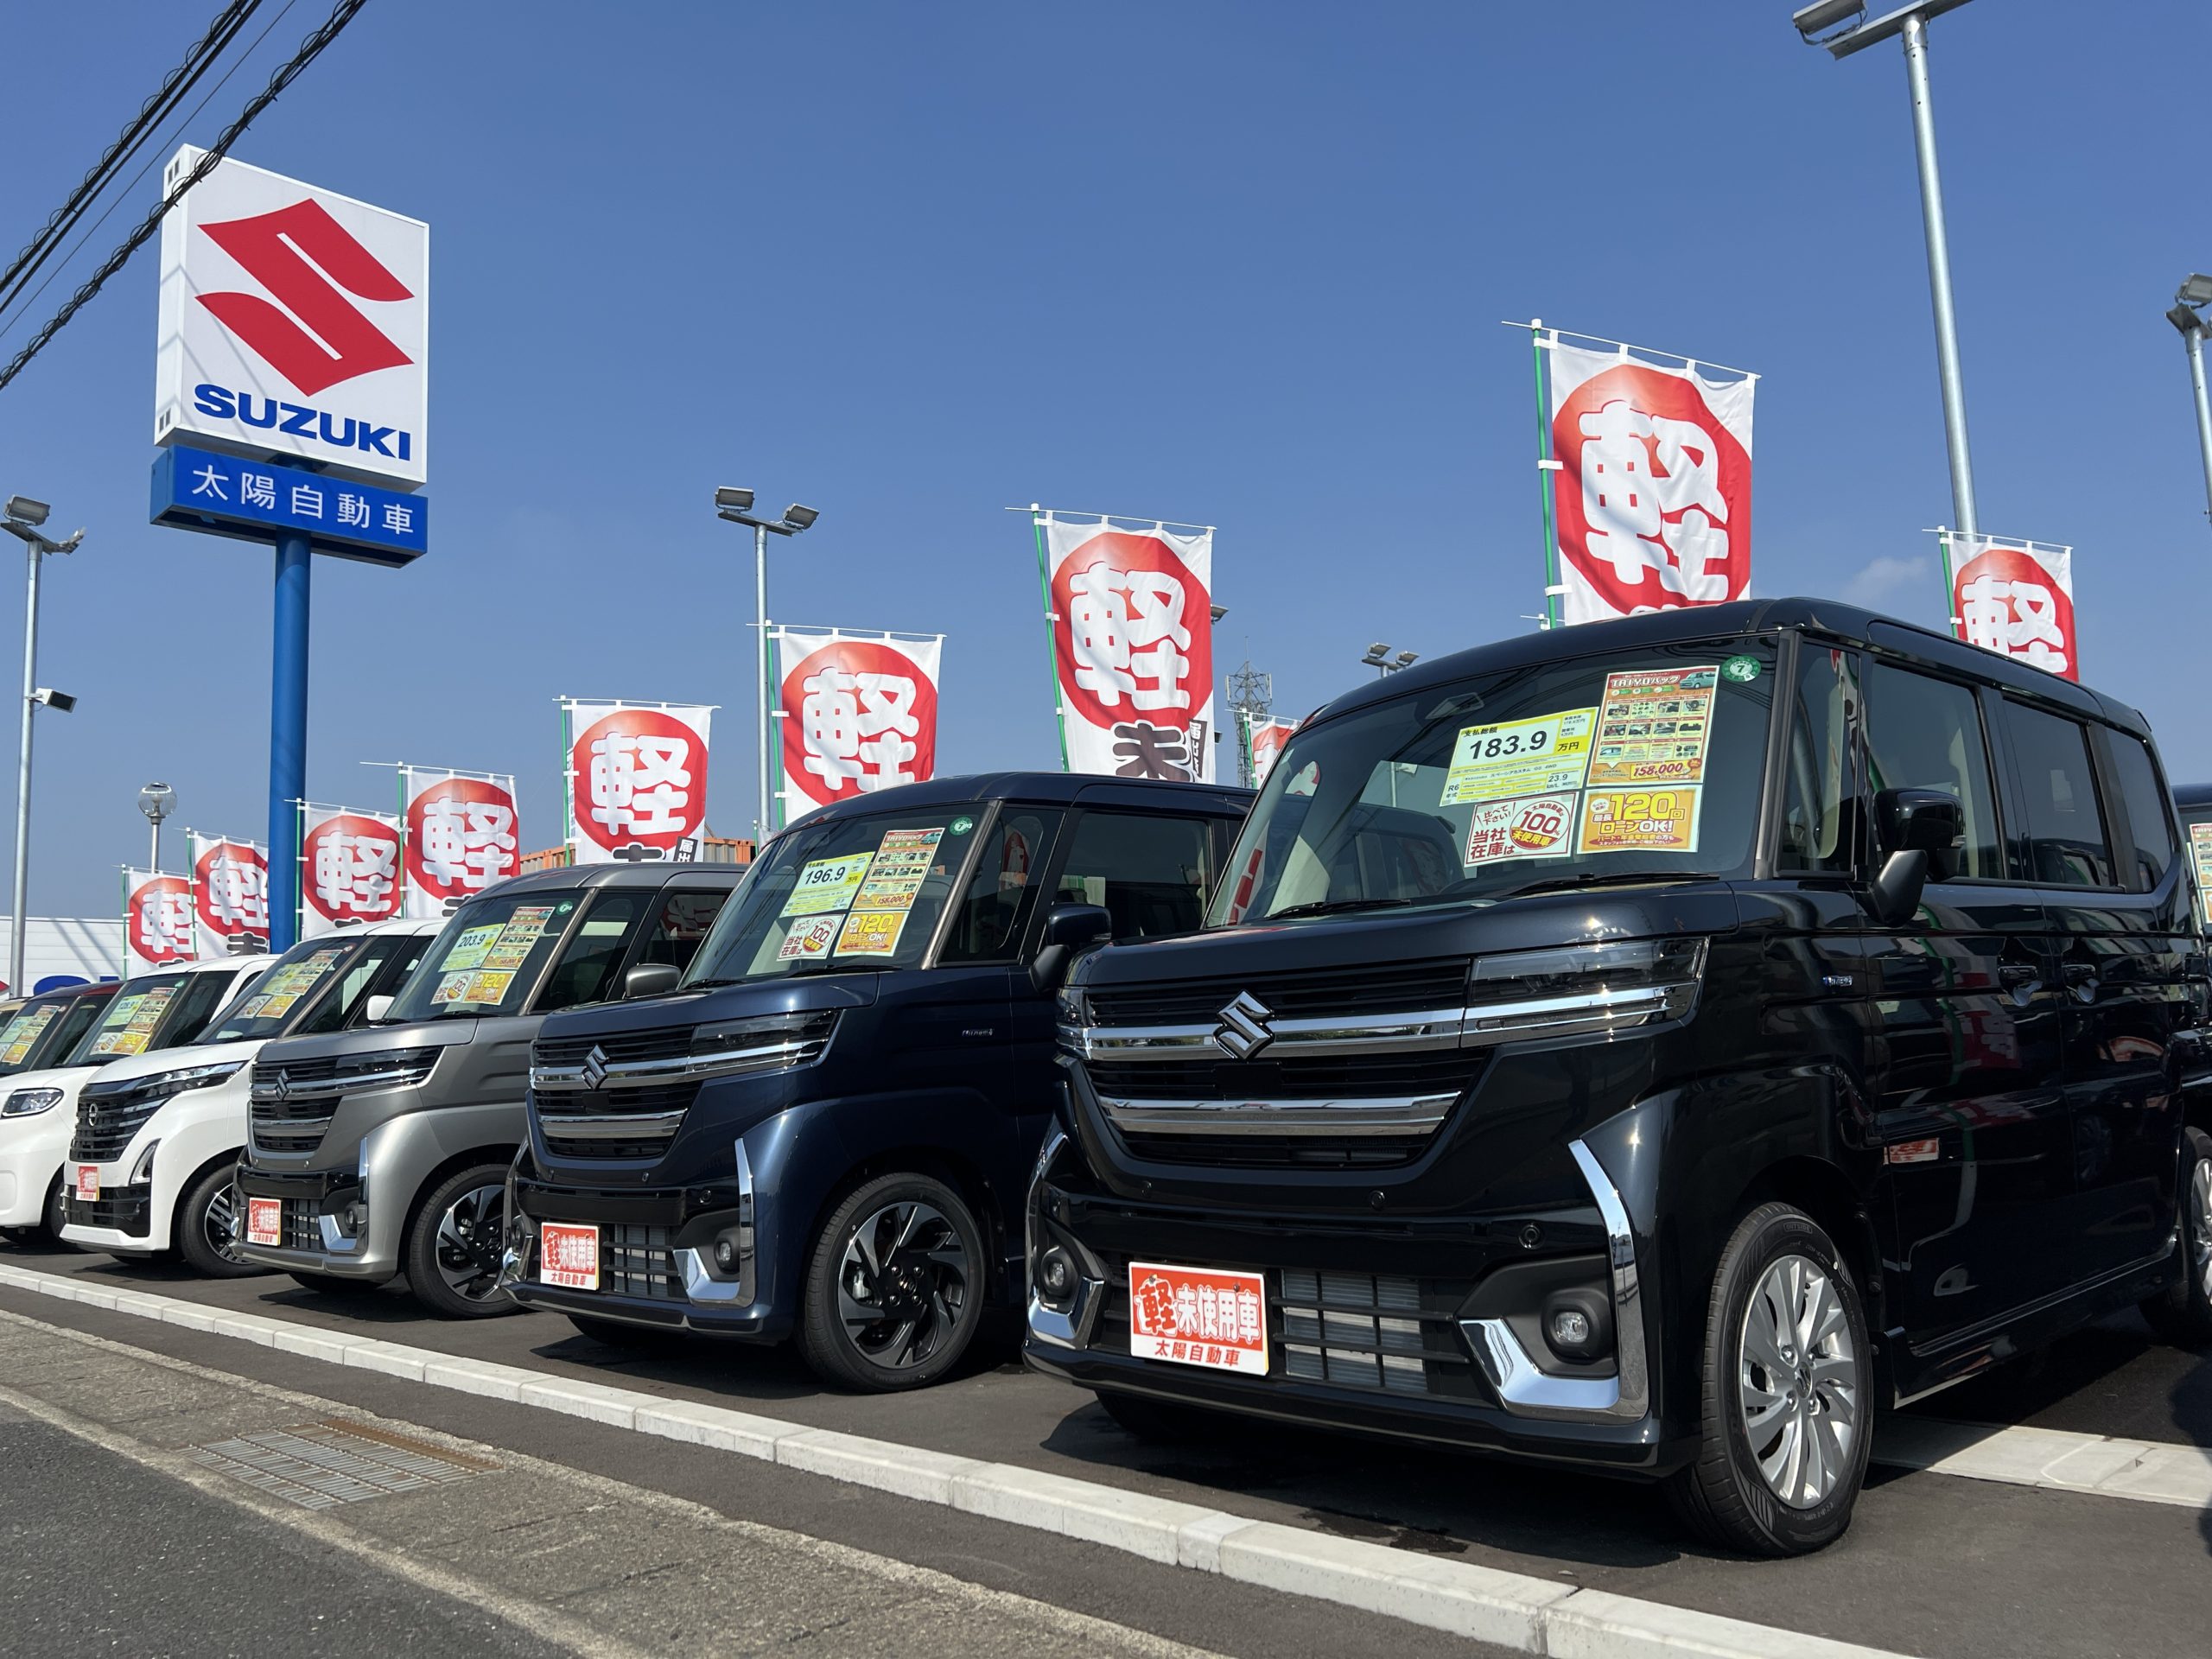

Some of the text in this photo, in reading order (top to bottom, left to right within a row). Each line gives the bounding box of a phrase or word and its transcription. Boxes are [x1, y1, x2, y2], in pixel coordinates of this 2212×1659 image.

[194, 384, 410, 461] SUZUKI
[192, 464, 414, 535] 太陽自動車
[1579, 400, 1729, 601] 軽
[1069, 562, 1192, 710] 軽
[1961, 575, 2069, 674] 軽
[1737, 664, 1745, 673] 7
[803, 667, 920, 791] 軽
[1469, 730, 1548, 760] 183.9
[1557, 741, 1580, 753] 万円
[590, 733, 691, 836] 軽
[1447, 784, 1459, 792] R6
[1548, 774, 1568, 783] 23.9
[1484, 804, 1509, 818] 比べて
[422, 797, 517, 888] 軽
[1472, 827, 1507, 844] 当社
[1512, 830, 1553, 847] 未使用車
[1599, 820, 1673, 835] ローンOK!
[1470, 842, 1516, 860] 在庫は
[315, 831, 397, 912] 軽
[804, 866, 846, 886] 196.9
[208, 855, 270, 929] 軽
[141, 889, 200, 954] 軽
[458, 934, 486, 948] 203.9
[546, 1233, 595, 1272] 軽未使用車
[550, 1271, 587, 1286] 太陽自動車
[1137, 1280, 1262, 1344] 軽未使用車
[1154, 1339, 1241, 1366] 太陽自動車
